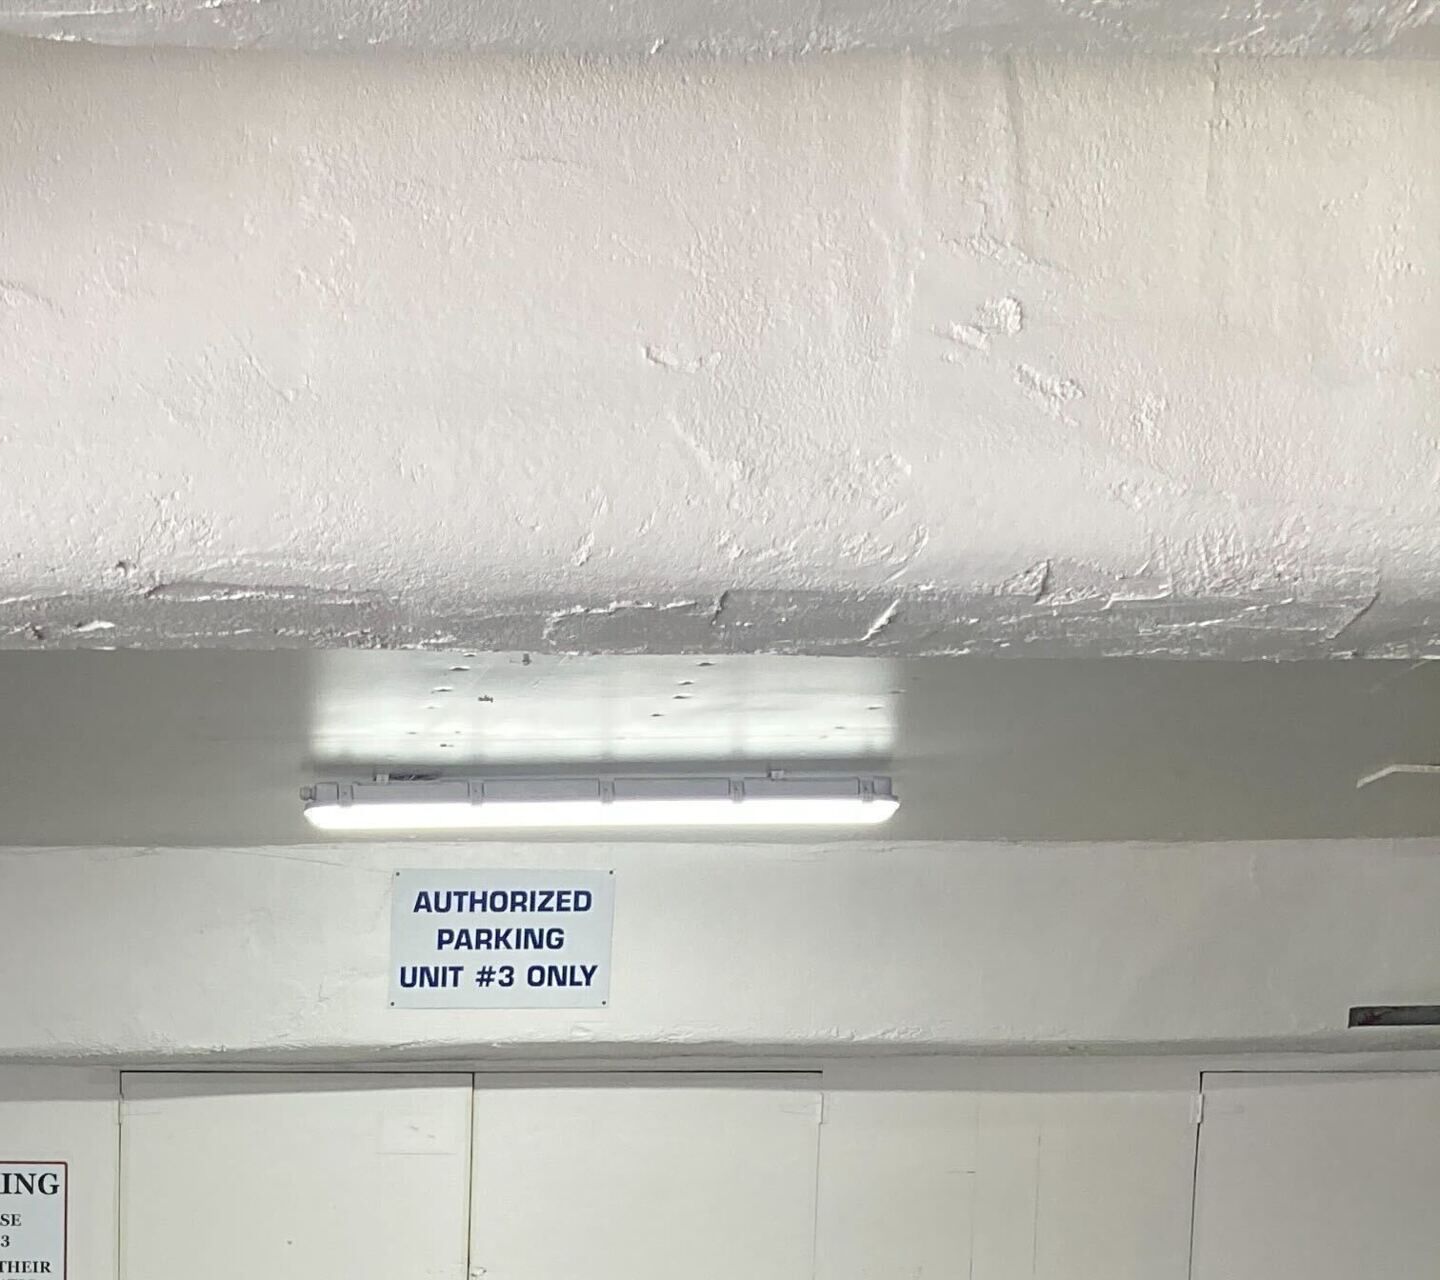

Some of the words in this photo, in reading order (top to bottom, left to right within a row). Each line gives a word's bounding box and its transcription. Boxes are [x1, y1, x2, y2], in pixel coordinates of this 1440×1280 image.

[413, 890, 593, 913] AUTHORIZED
[437, 928, 565, 951] PARKING
[400, 966, 464, 988] UNIT
[475, 965, 515, 988] #3
[527, 965, 598, 987] ONLY
